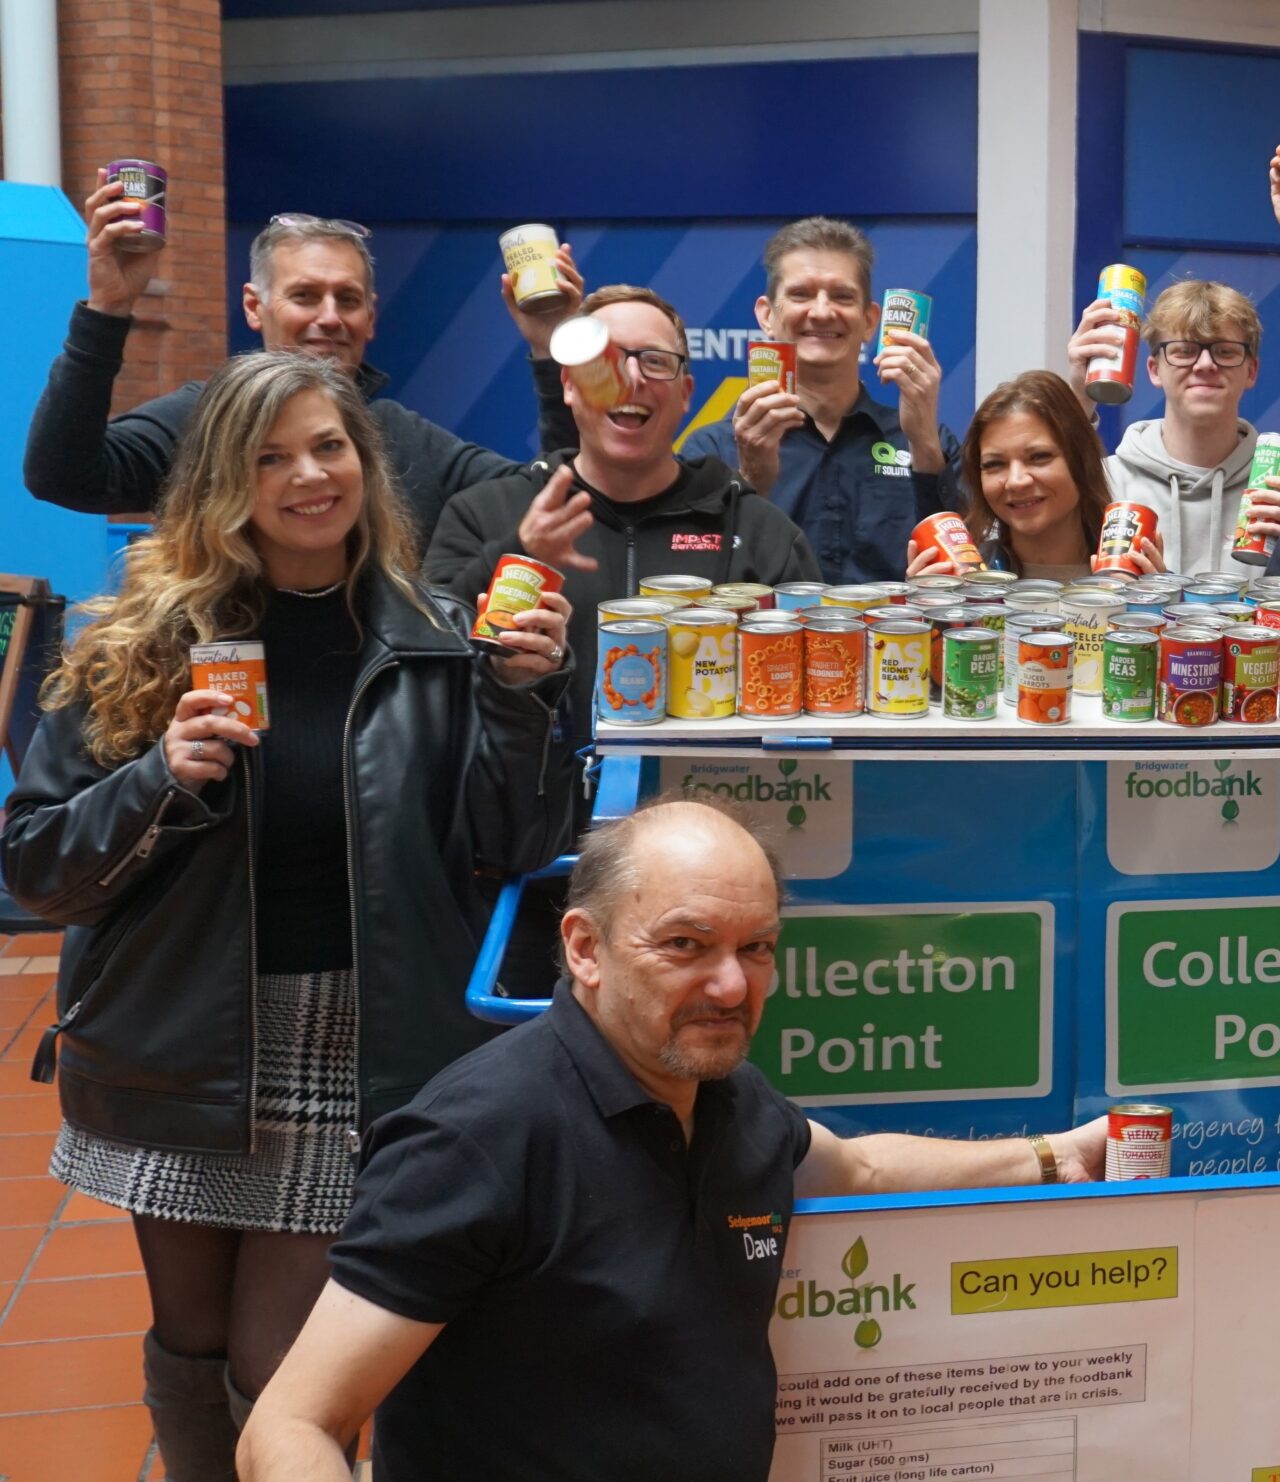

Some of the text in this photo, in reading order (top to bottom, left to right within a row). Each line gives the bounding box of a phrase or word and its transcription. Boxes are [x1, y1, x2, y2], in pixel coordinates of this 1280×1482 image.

[888, 298, 911, 308] HEINZ
[884, 310, 913, 323] BEANZ
[1107, 510, 1135, 522] HEINZ
[1103, 527, 1135, 538] TOMATO
[505, 569, 540, 587] HEINZ
[695, 660, 717, 668] NEW
[971, 662, 996, 674] PEAS
[1109, 663, 1136, 676] PEAS
[208, 671, 248, 682] BAKED
[882, 666, 914, 675] KIDNEY
[882, 673, 910, 681] BEANS
[1182, 677, 1213, 686] SOUP
[1250, 674, 1277, 683] SOUP
[209, 682, 248, 693] BEANS
[691, 764, 750, 775] Bridgwater
[1135, 762, 1189, 772] Bridgwater
[1125, 771, 1262, 798] foodbank
[780, 1022, 942, 1075] Point
[1126, 1130, 1159, 1142] HEINZ
[1188, 1153, 1267, 1177] people
[743, 1233, 777, 1260] Dave
[960, 1257, 1167, 1296] Can you help?
[779, 1352, 1133, 1391] could add one of these items to your weekly
[820, 1369, 1133, 1405] would be gratefully received by the foodbank
[800, 1393, 1061, 1425] will pass on to local people that are
[828, 1441, 853, 1454] Milk
[828, 1455, 895, 1471] Sugar (500
[929, 1462, 994, 1478] life carton)
